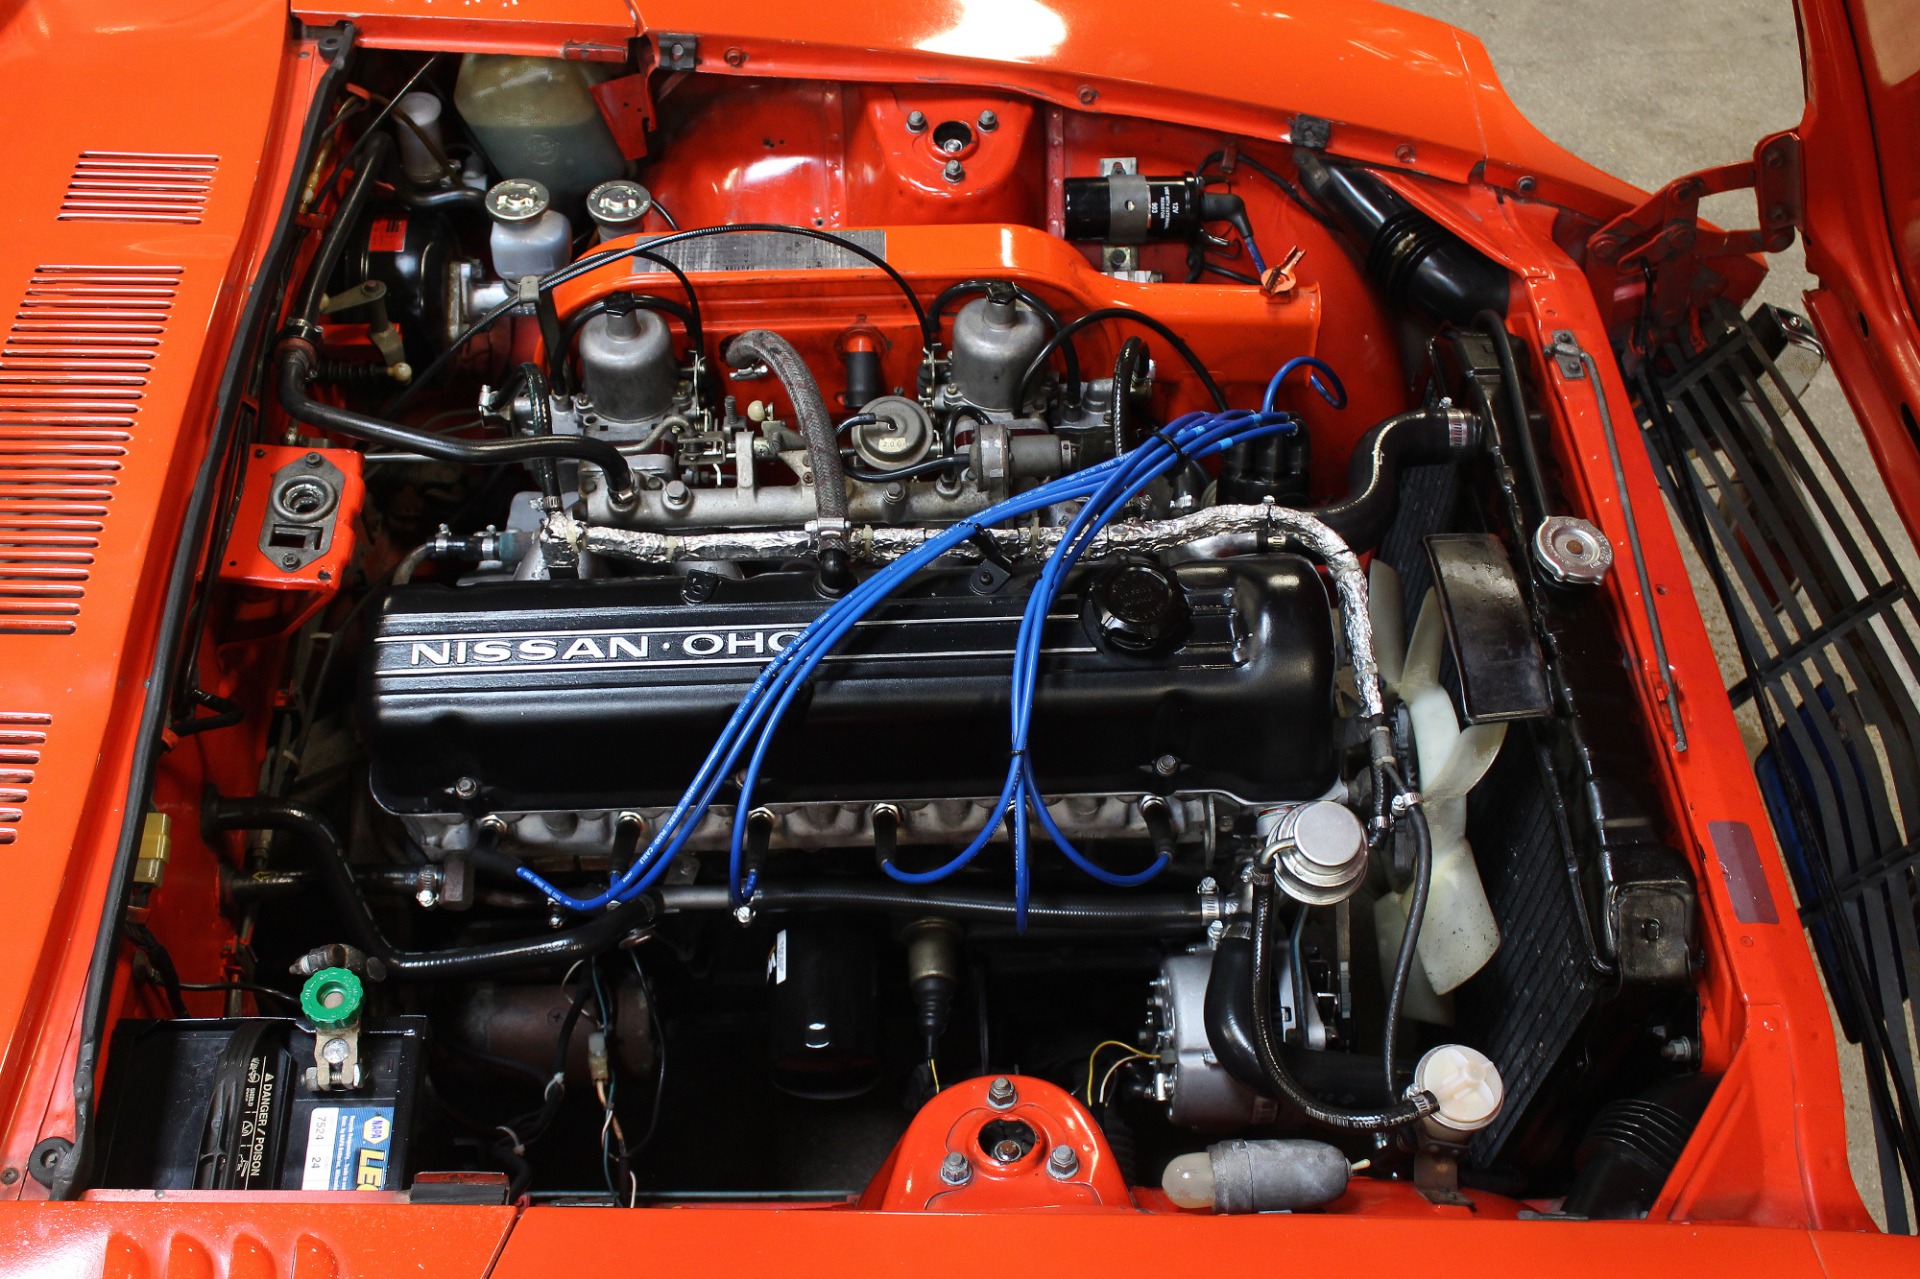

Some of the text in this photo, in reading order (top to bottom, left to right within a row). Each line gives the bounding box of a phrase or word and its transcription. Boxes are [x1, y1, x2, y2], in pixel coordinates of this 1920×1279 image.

[410, 632, 650, 667] NISSAN
[762, 660, 782, 678] SPARK
[779, 646, 793, 660] PLUG
[793, 630, 810, 646] CABLE
[817, 612, 830, 625] JAPAN
[666, 805, 683, 827] SPARK
[654, 828, 667, 845] PLUG
[639, 847, 653, 865] CABLE
[622, 870, 634, 884] JAPAN
[248, 1087, 256, 1107] SHIELD
[257, 1084, 272, 1127] DANGER
[315, 1116, 327, 1140] 7524
[370, 1120, 383, 1139] NAPA
[250, 1137, 264, 1177] POISON
[311, 1156, 321, 1169] 24
